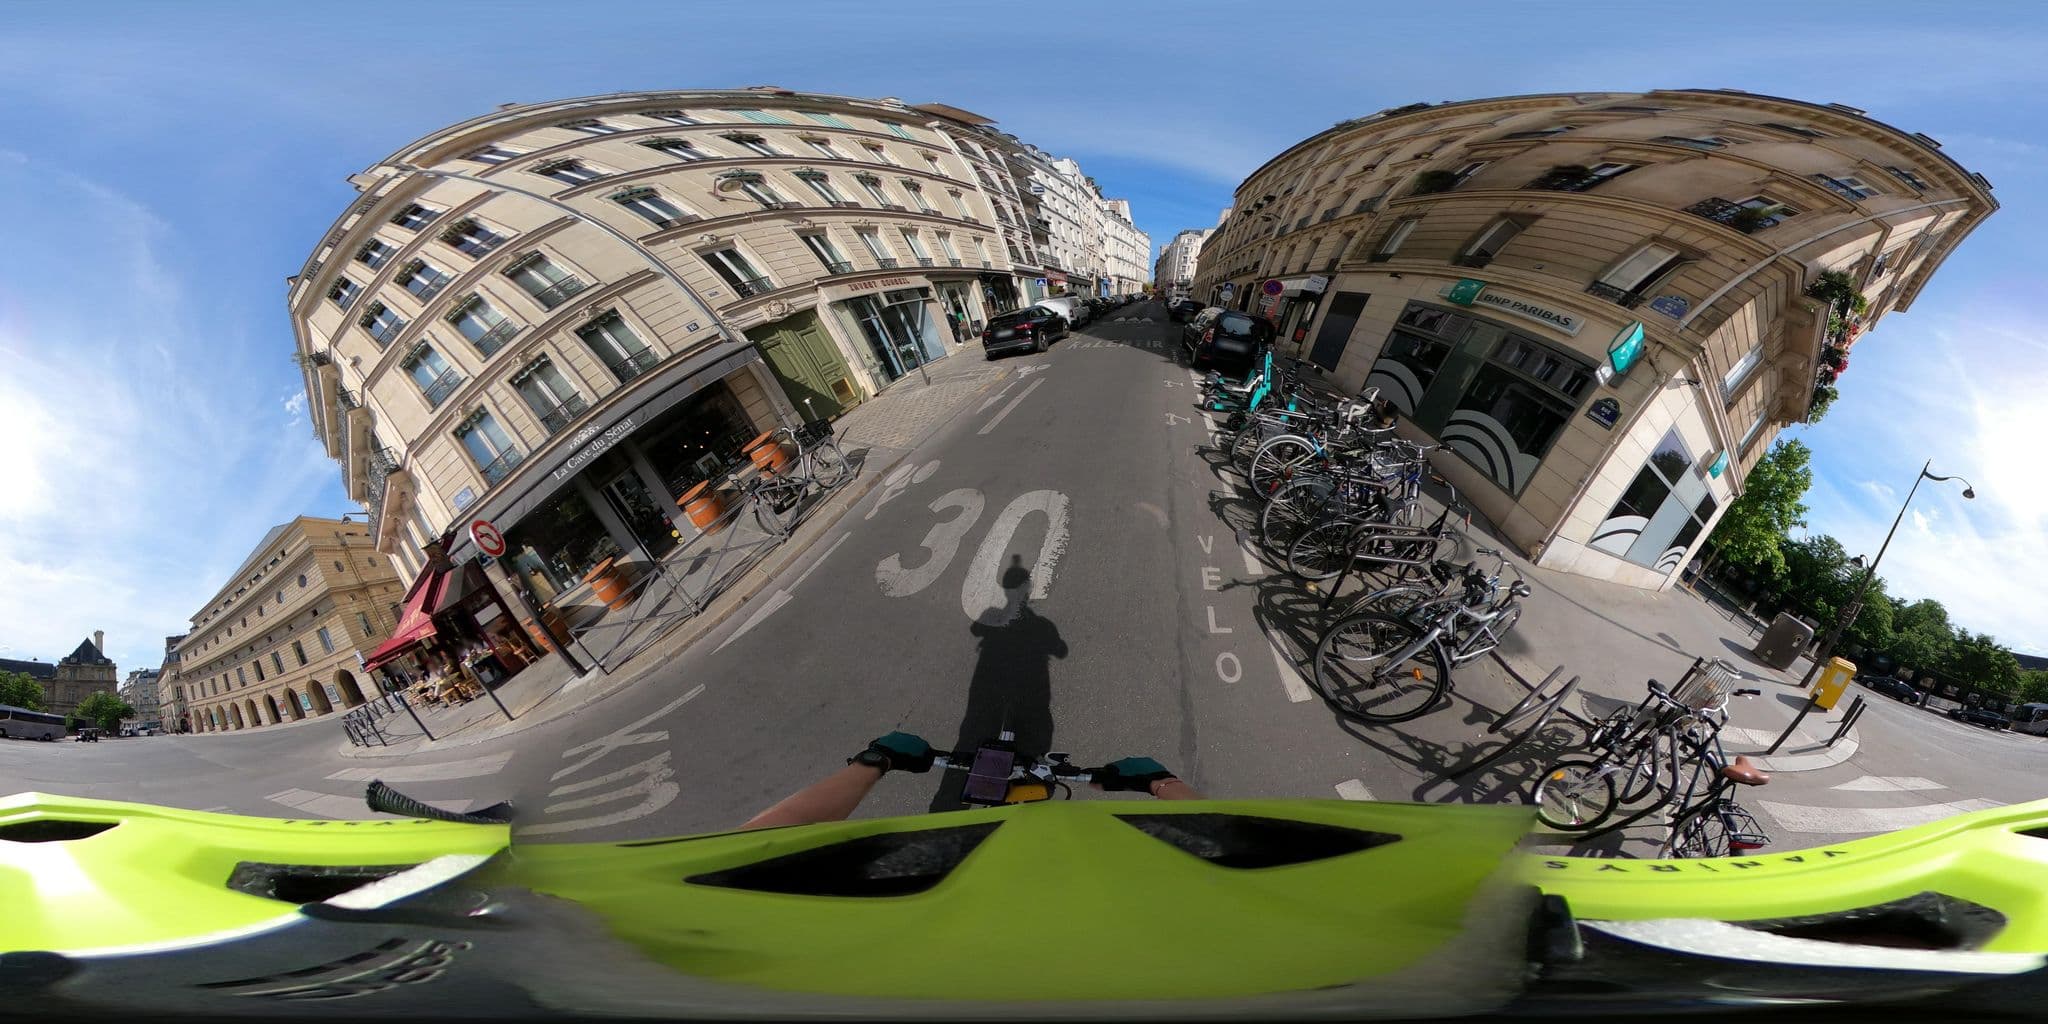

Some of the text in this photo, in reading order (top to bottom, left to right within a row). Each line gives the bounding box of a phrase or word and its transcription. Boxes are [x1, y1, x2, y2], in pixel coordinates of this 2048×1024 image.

[1483, 294, 1573, 326] BNP PARIBAS
[552, 466, 569, 481] La
[566, 449, 592, 469] Cave
[591, 438, 606, 452] du
[604, 418, 634, 441] Sénat
[874, 487, 1073, 628] 30
